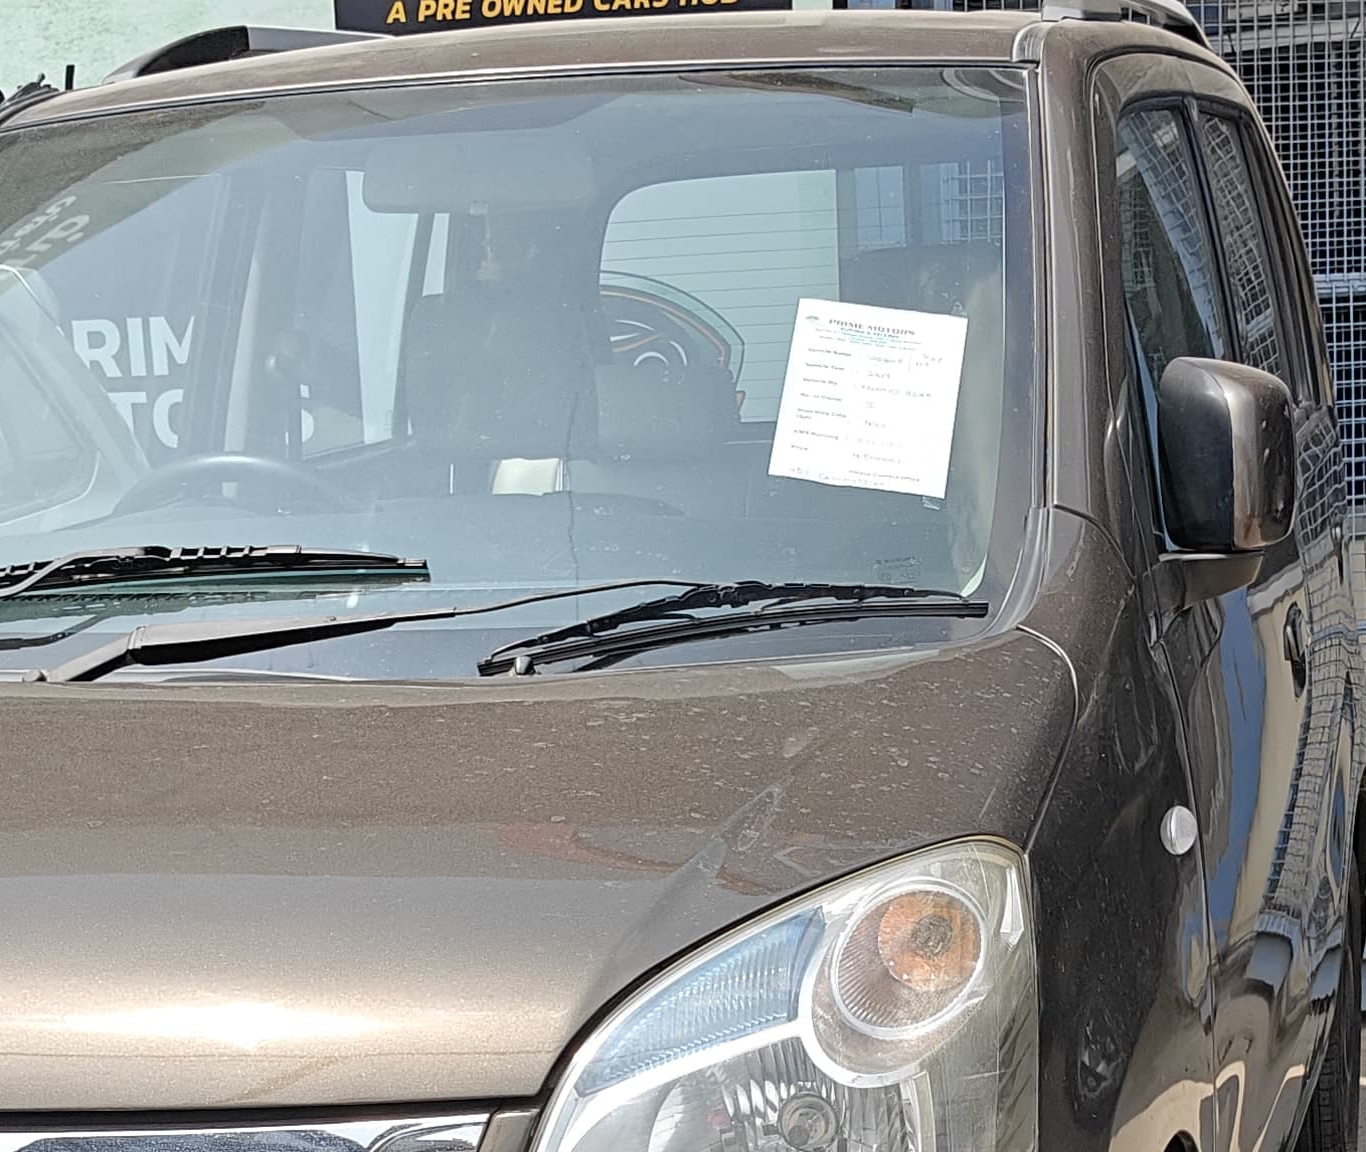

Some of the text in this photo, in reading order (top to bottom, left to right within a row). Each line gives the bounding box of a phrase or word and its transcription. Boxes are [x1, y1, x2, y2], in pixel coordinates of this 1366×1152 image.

[386, 0, 407, 24] A
[418, 0, 471, 22] PRE
[481, 0, 583, 17] OWNED
[71, 315, 195, 378] RIM
